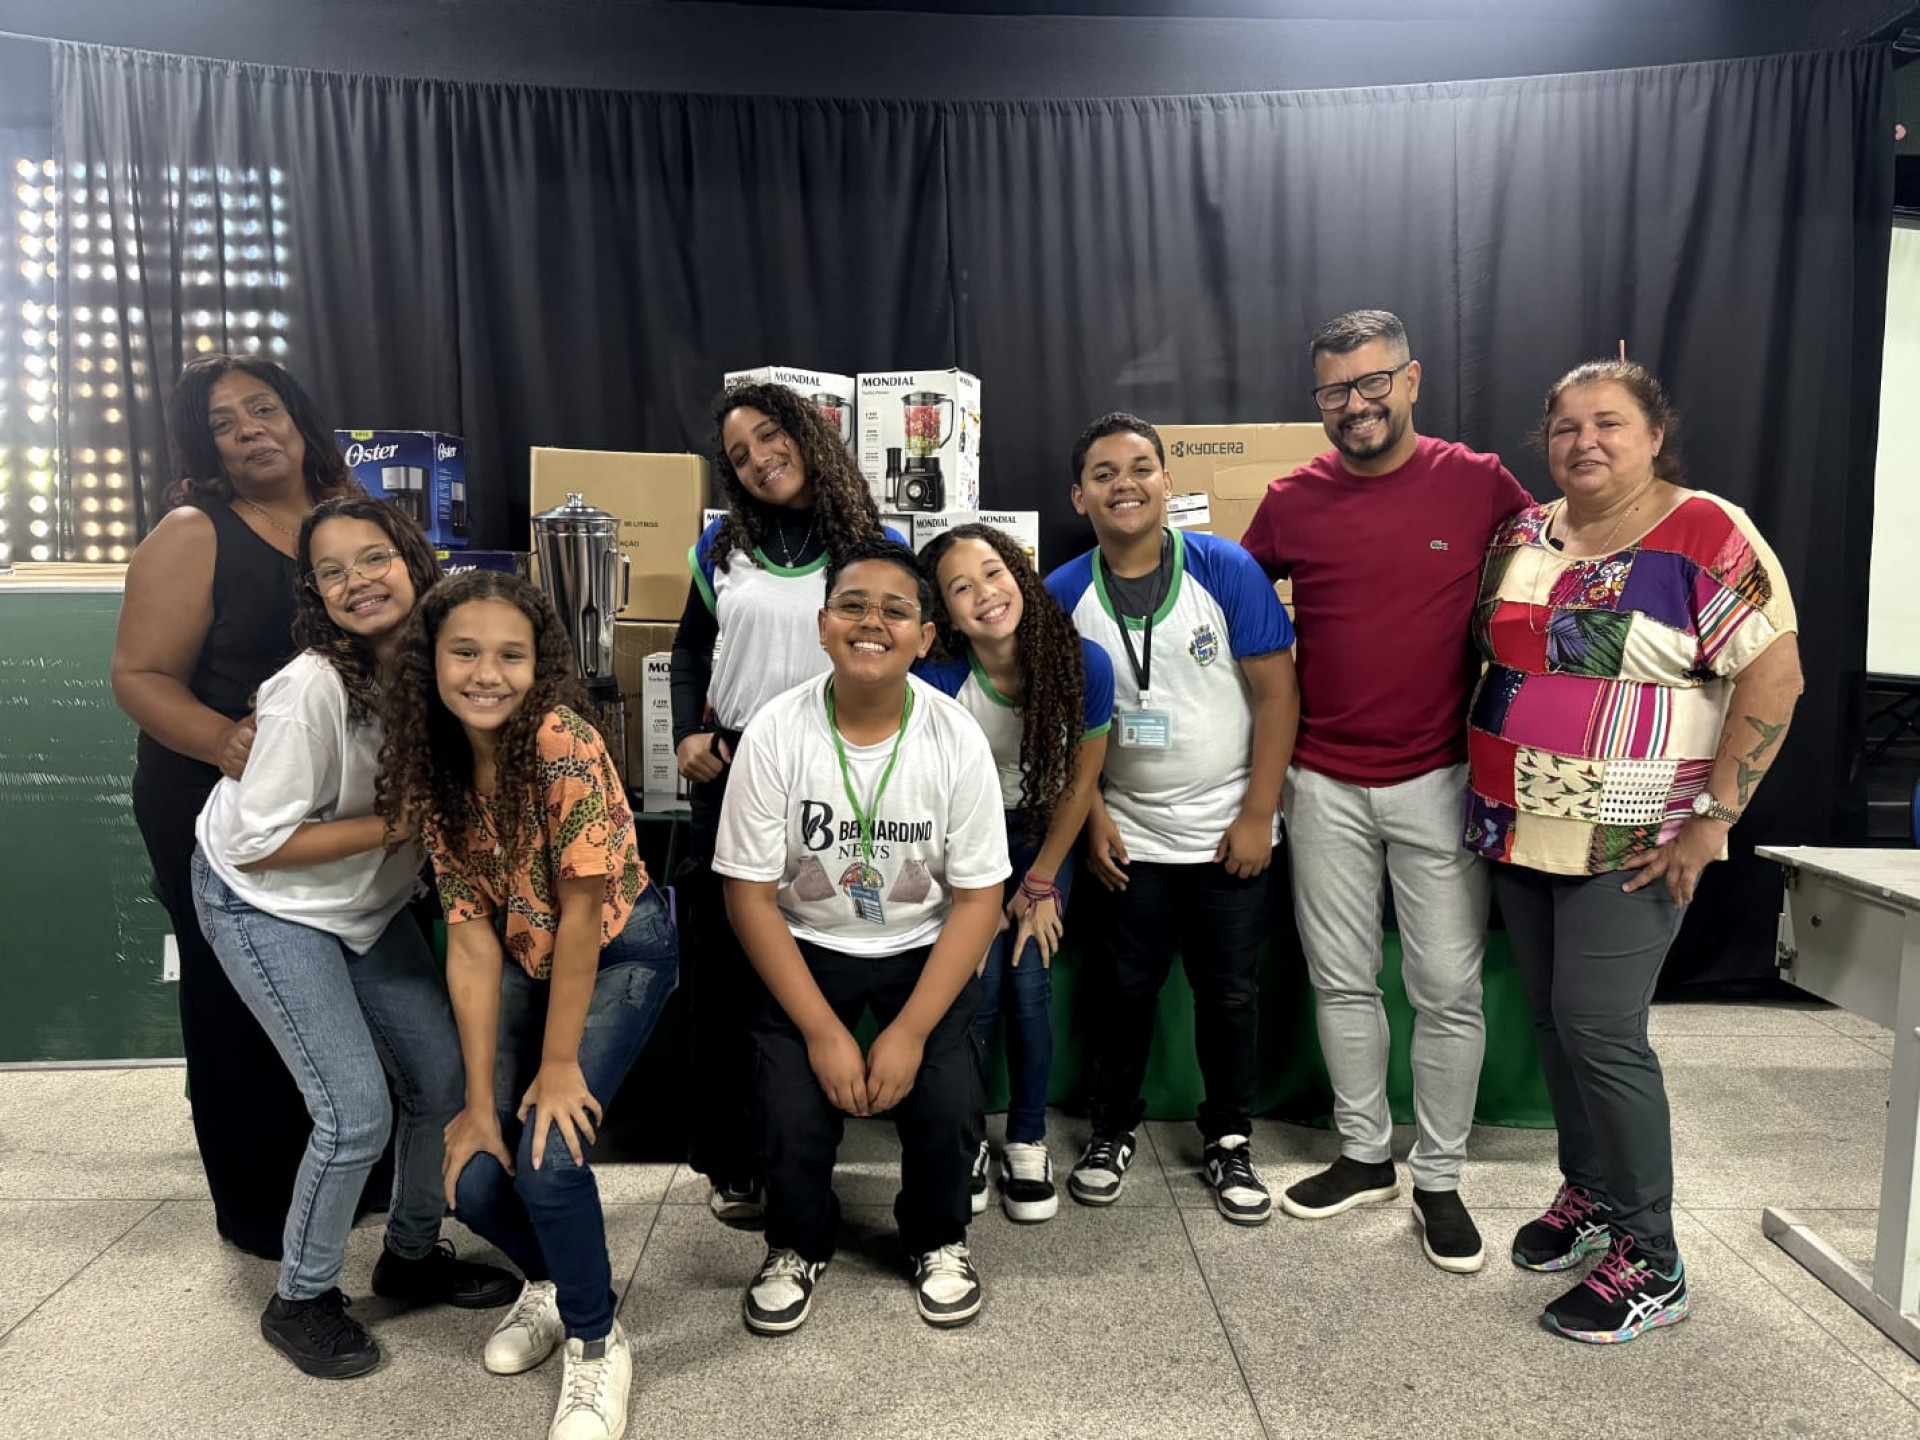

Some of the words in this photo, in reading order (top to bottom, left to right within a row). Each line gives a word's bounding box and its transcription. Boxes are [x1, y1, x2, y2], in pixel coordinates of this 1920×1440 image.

[774, 371, 821, 387] MONDIAL
[861, 376, 916, 387] MONDIAL
[437, 442, 458, 462] Oster
[1186, 442, 1245, 456] KYOCERA
[344, 443, 399, 468] Oster
[916, 518, 948, 528] MONDIAL
[979, 515, 1017, 524] MONDIAL
[647, 662, 672, 673] MO
